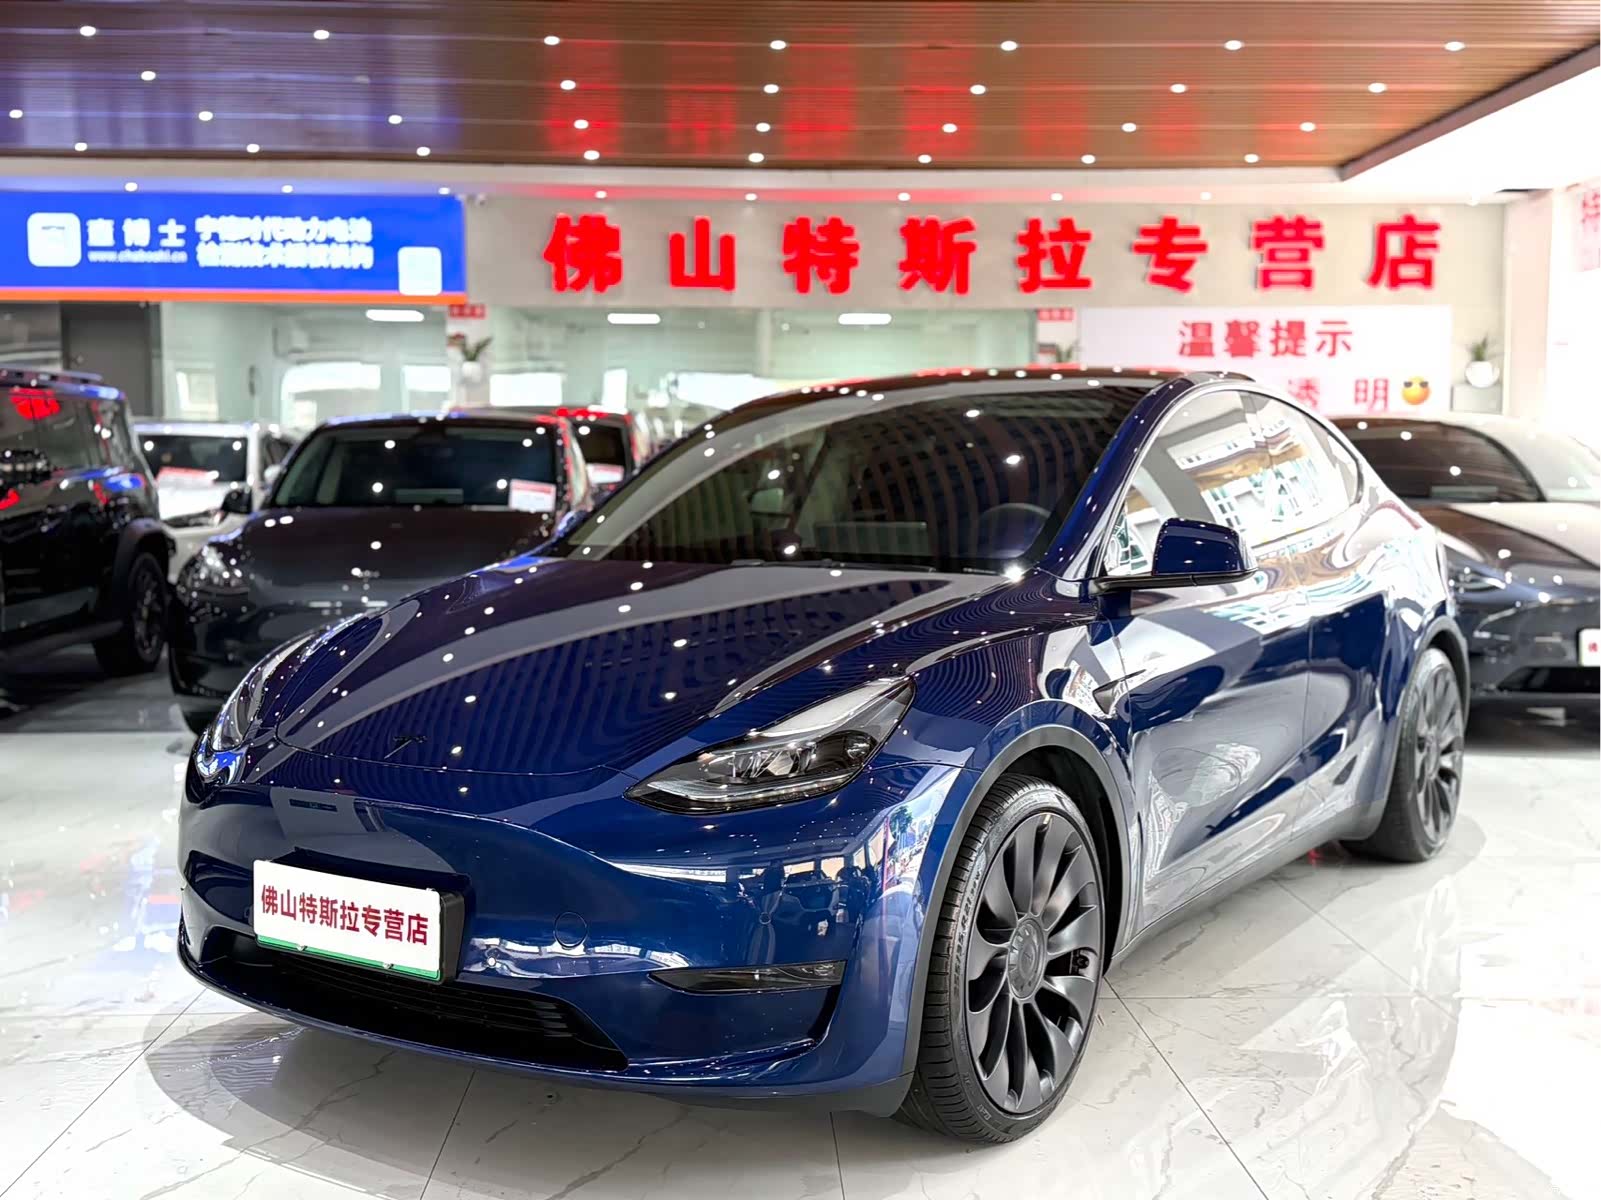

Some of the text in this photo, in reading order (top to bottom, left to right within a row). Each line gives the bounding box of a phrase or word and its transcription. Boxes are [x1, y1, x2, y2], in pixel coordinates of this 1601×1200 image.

[543, 213, 1440, 295] 佛山特斯拉专营店
[1178, 319, 1353, 358] 温馨提示
[260, 884, 429, 946] 佛山特斯拉专营店
